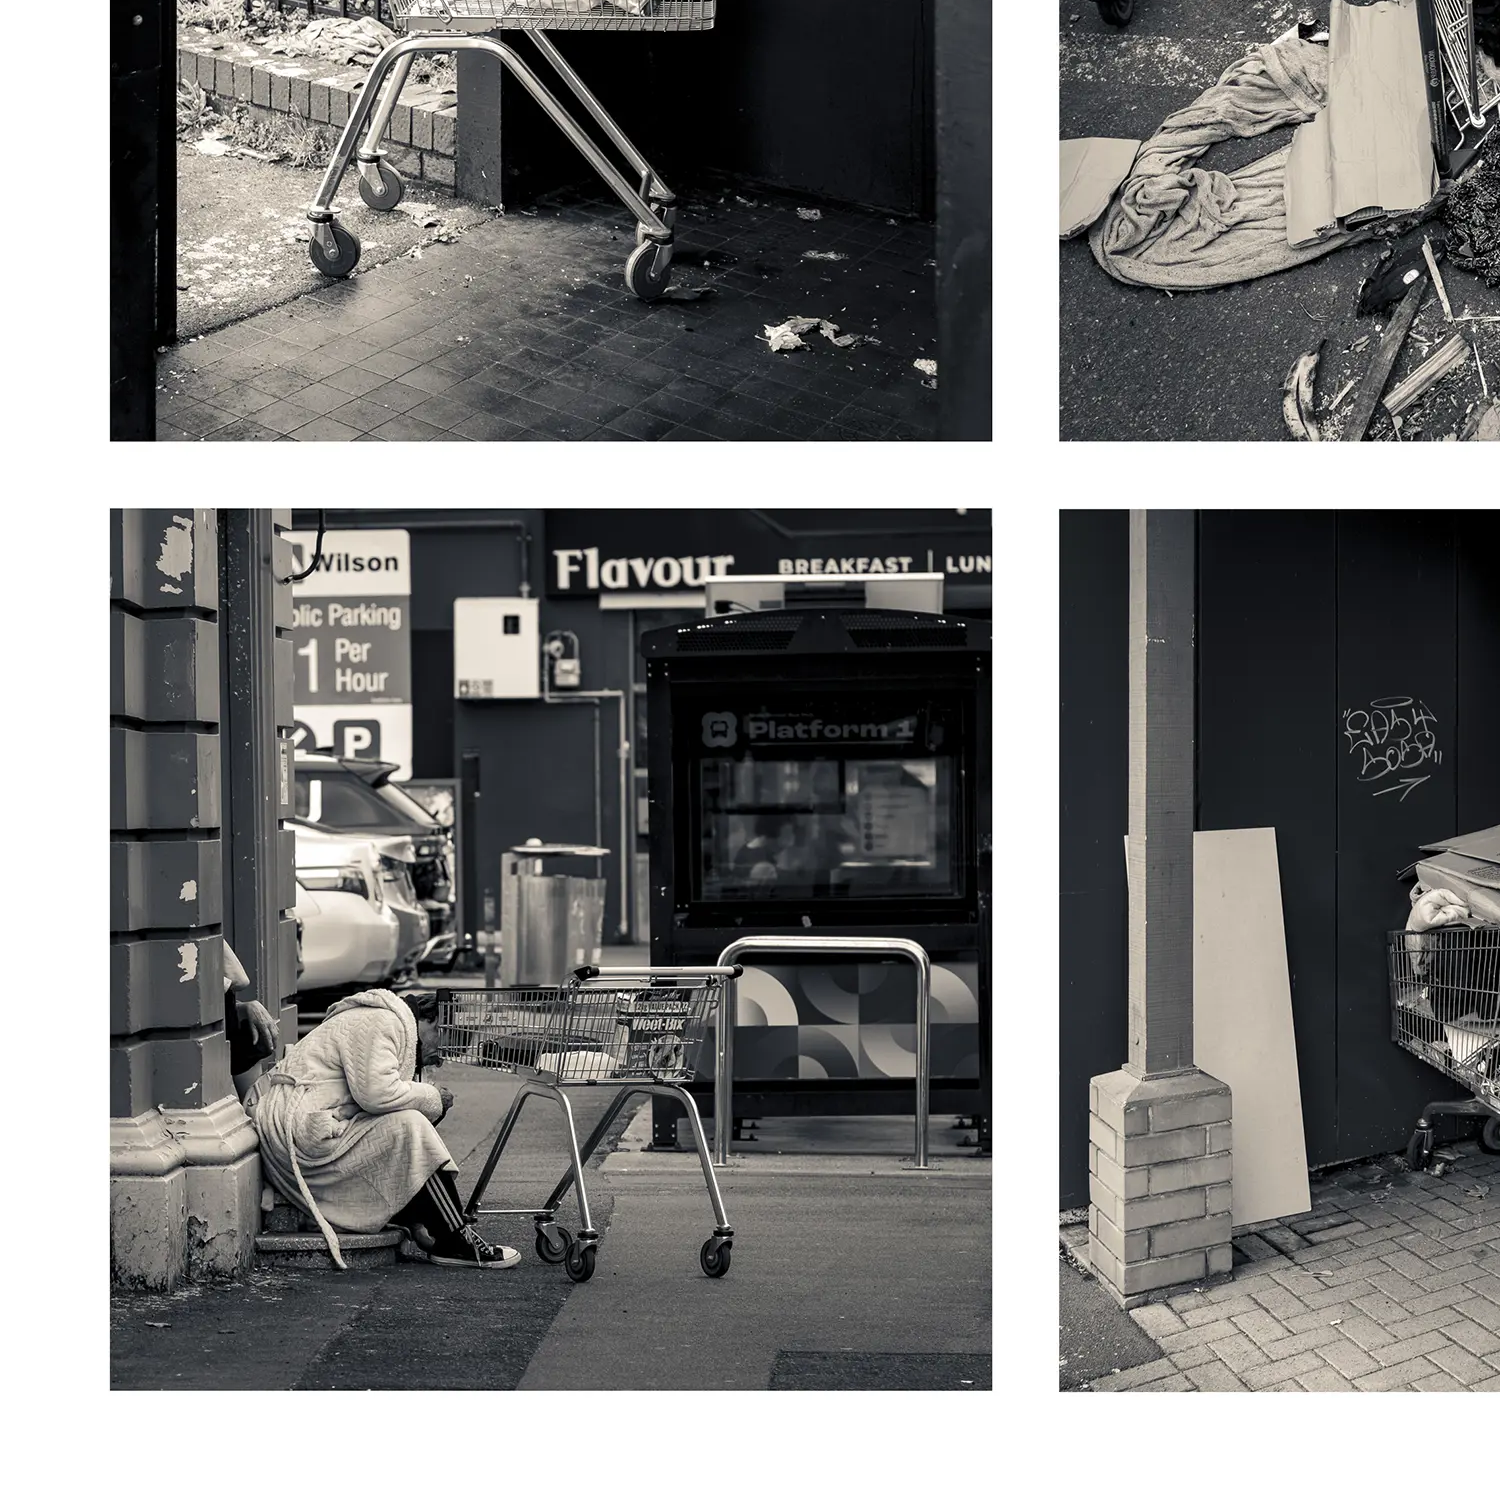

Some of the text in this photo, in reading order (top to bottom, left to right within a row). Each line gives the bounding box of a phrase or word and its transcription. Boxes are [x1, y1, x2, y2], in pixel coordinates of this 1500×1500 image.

[311, 553, 399, 572] Wilson
[553, 547, 735, 589] Flavour
[778, 556, 913, 575] BREAKFAST
[328, 603, 402, 631] Parking
[334, 638, 372, 663] Per
[335, 667, 389, 692] Hour
[750, 719, 914, 740] Platform 1
